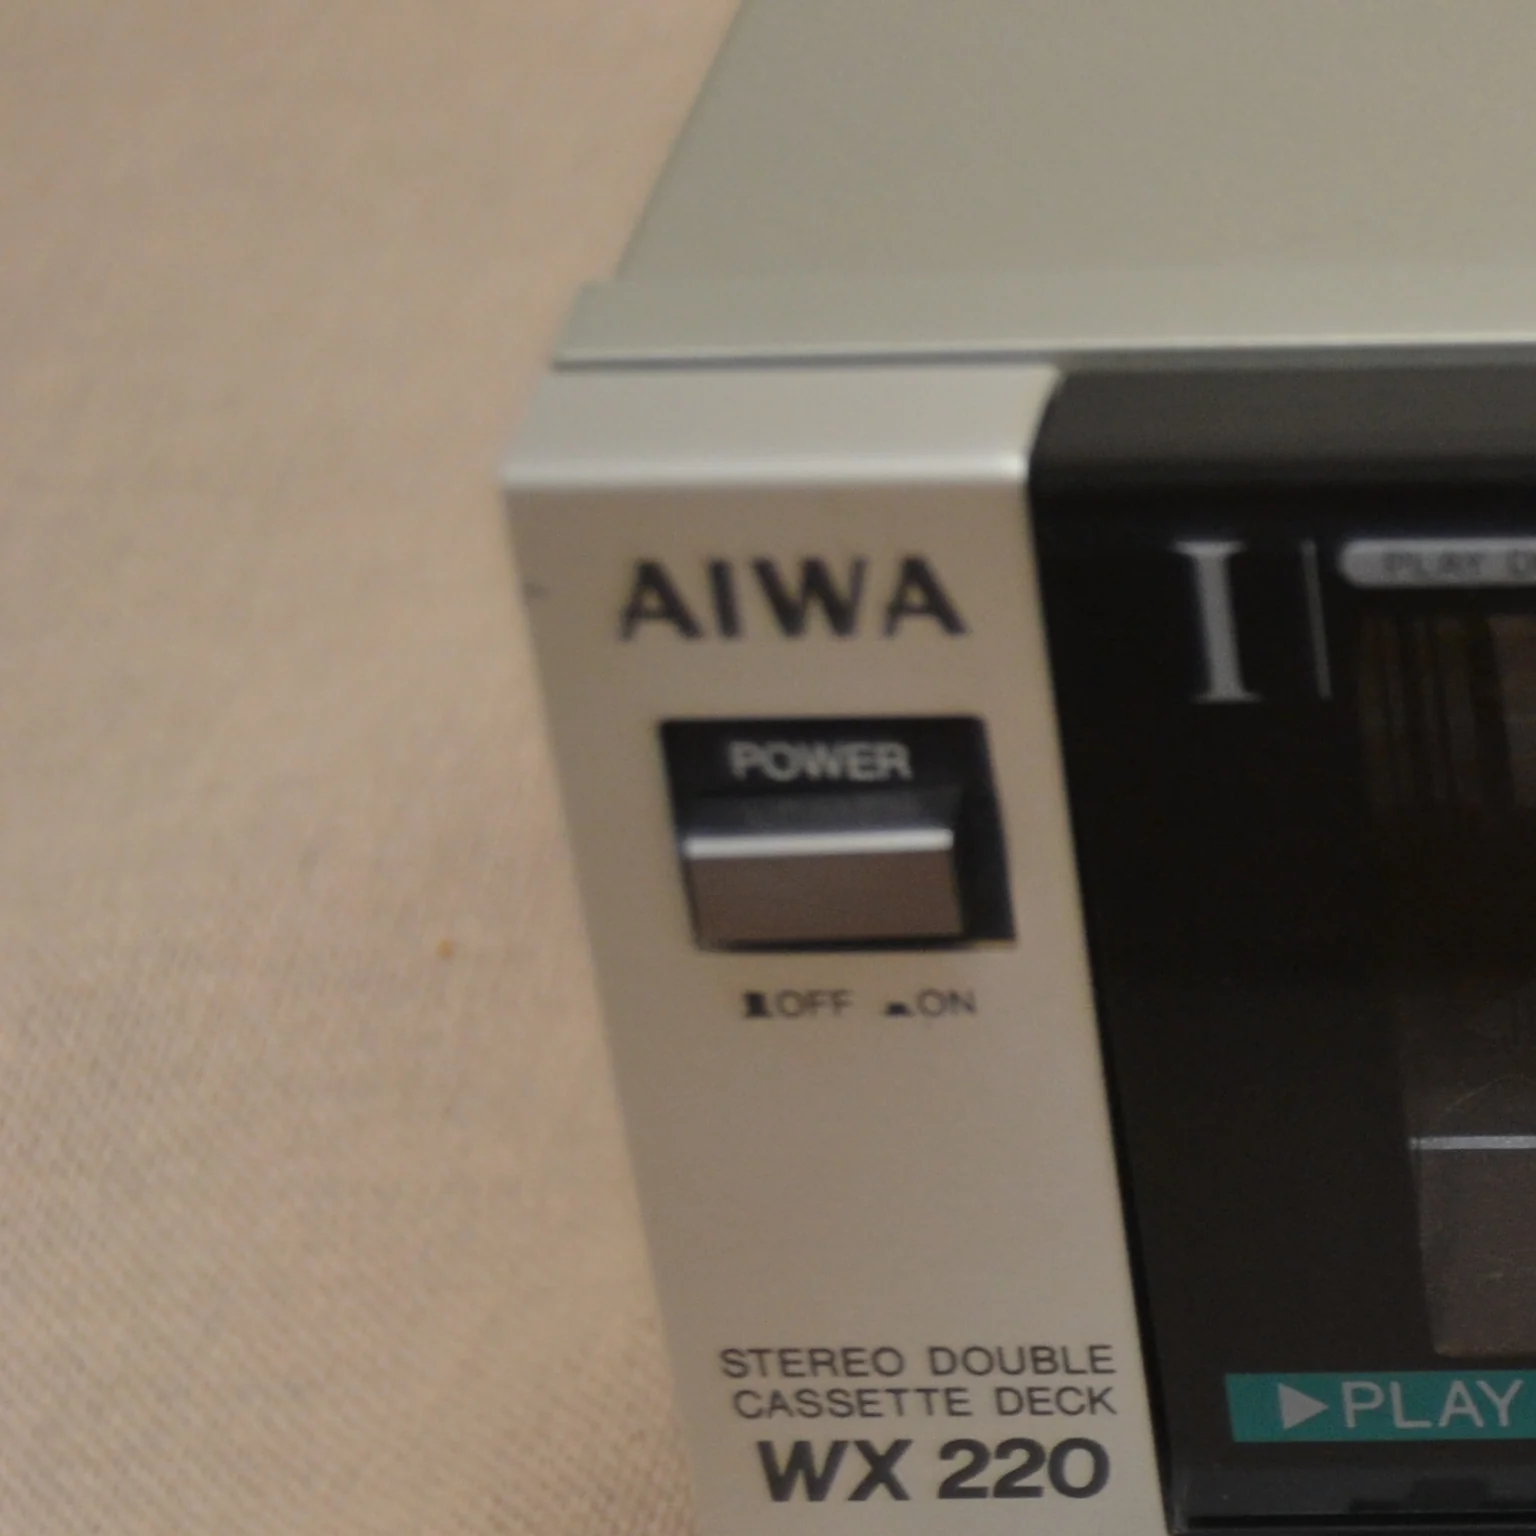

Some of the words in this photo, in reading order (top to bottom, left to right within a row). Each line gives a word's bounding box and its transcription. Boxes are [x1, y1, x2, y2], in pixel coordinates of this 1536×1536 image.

[620, 556, 965, 639] AIWA
[729, 741, 912, 781] POWER
[773, 988, 849, 1019] OFF
[914, 987, 976, 1018] ON
[718, 1346, 904, 1380] STEREO
[927, 1344, 1116, 1377] DOUBLE
[731, 1386, 972, 1420] CASSETTE
[993, 1385, 1116, 1417] DECK
[1341, 1379, 1523, 1429] PLAY
[756, 1438, 912, 1503] WX
[937, 1437, 1110, 1500] 220
